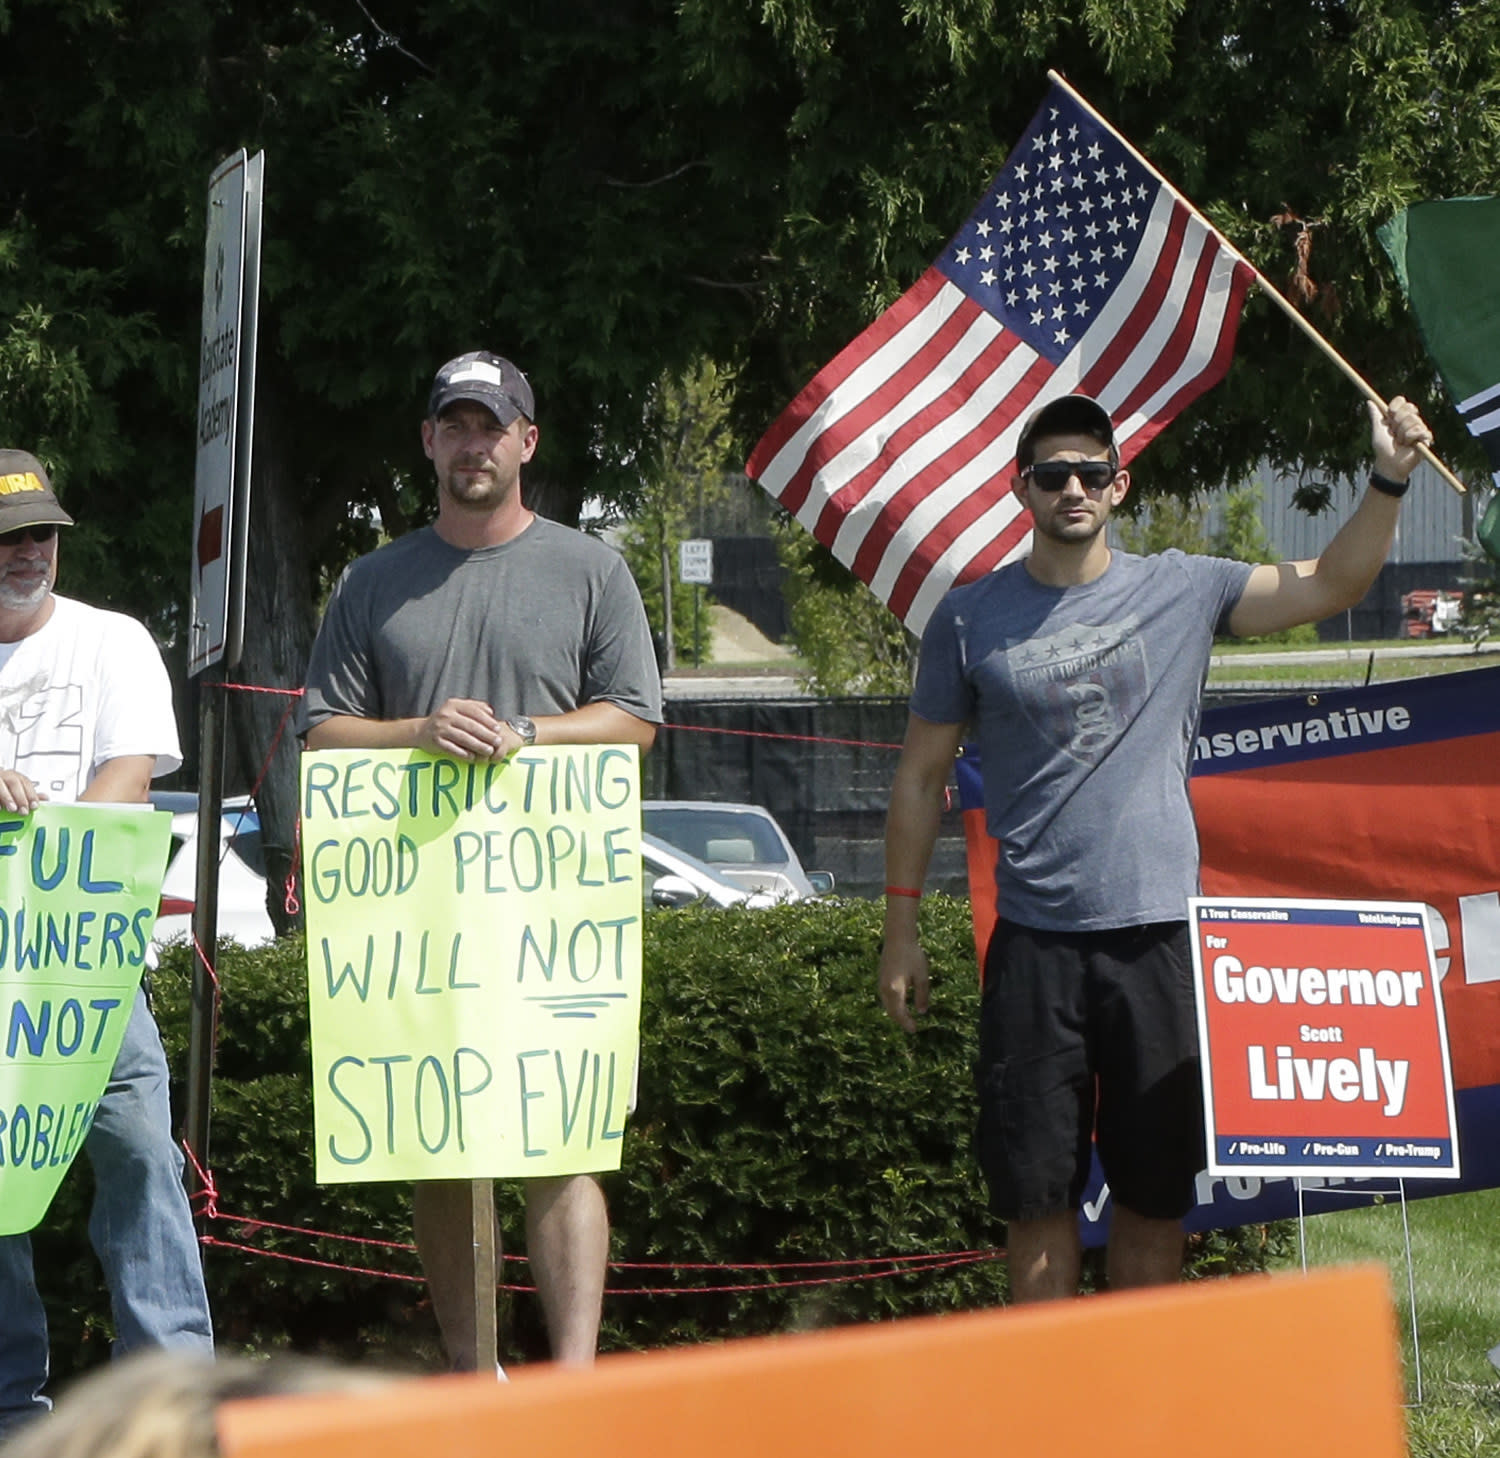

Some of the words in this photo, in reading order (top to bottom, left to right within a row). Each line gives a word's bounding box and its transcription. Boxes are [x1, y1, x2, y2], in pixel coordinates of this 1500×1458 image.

[306, 750, 631, 820] RESTRICTING
[312, 833, 420, 903] GOOD
[454, 825, 633, 893] PEOPLE
[322, 930, 480, 1002] WILL
[518, 916, 638, 982] NOT
[1205, 935, 1228, 949] For
[1212, 955, 1424, 1007] Governor
[6, 999, 121, 1057] NOT
[1300, 1025, 1343, 1043] Scott
[329, 1047, 492, 1165] STOP
[518, 1049, 623, 1157] EVIL
[1247, 1045, 1409, 1117] Lively
[1239, 1142, 1286, 1155] Pro-Life
